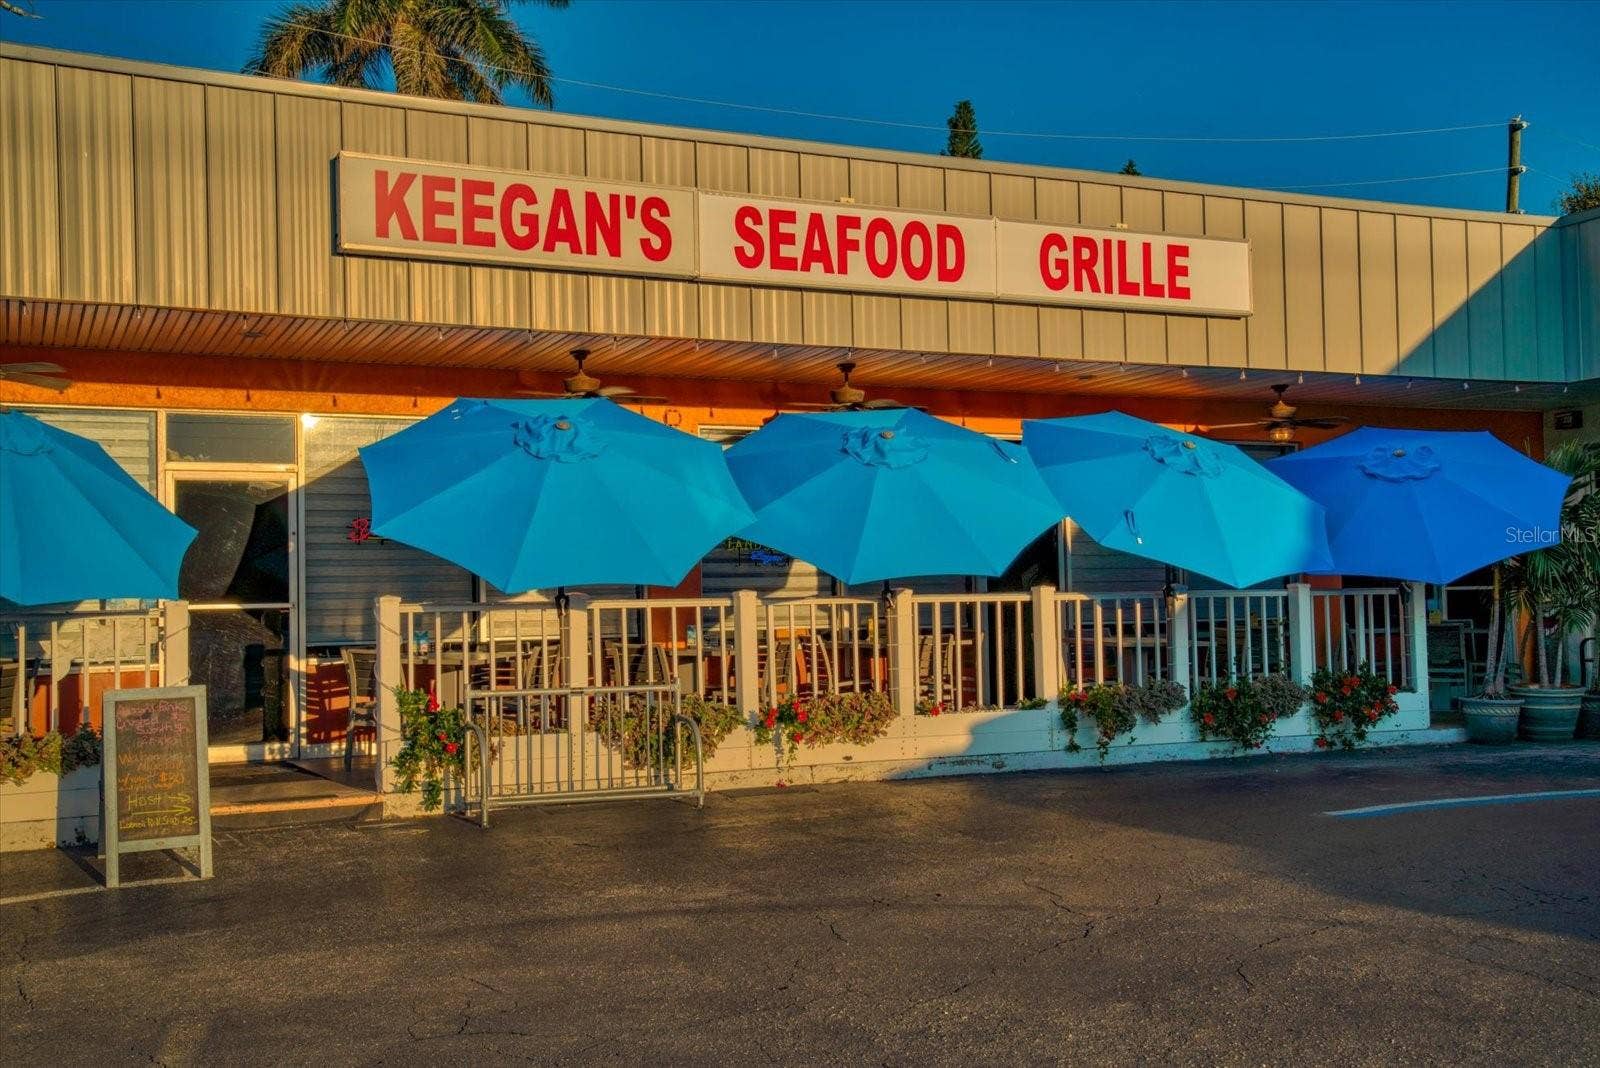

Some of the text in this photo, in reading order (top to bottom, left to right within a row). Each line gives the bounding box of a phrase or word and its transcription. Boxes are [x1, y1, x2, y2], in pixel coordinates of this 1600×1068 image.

[374, 168, 1192, 301] KEEGAN'S SEAFOOD GRILLE
